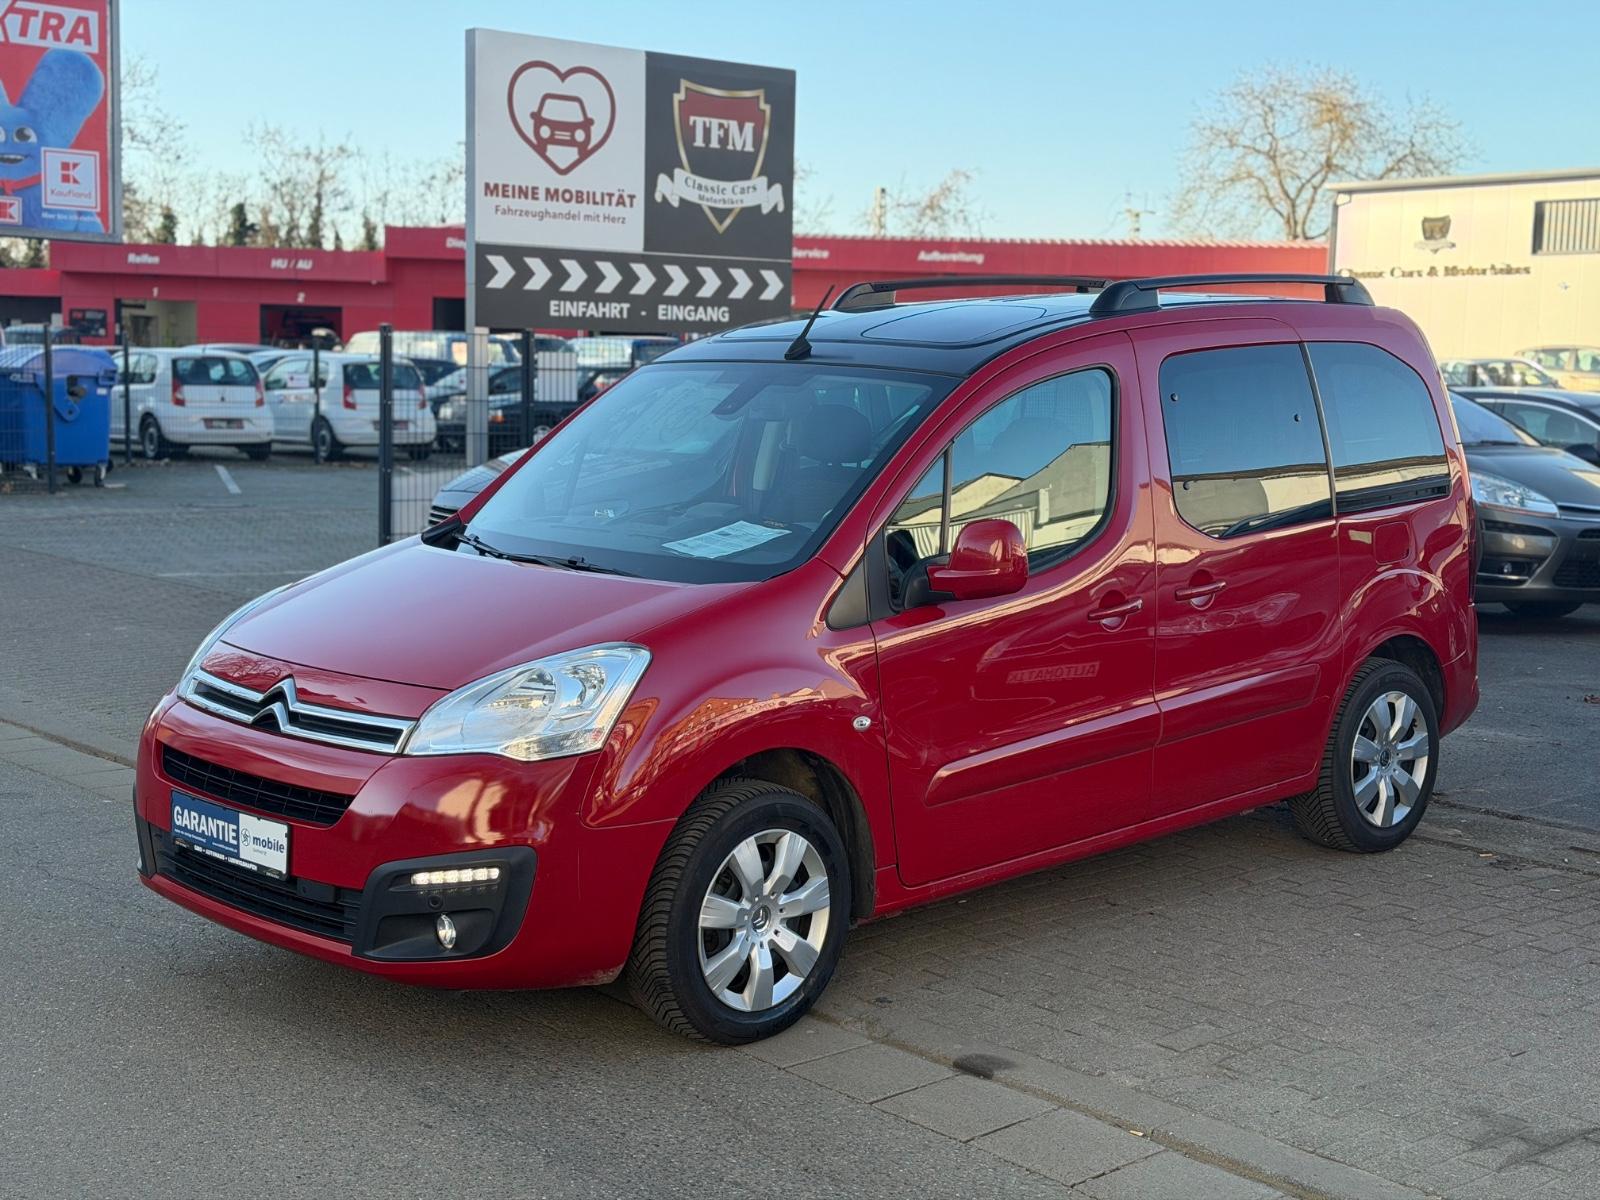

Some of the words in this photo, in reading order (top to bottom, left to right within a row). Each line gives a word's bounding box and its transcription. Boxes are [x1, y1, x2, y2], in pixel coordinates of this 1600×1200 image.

[689, 115, 755, 152] TFM
[483, 182, 540, 201] MEINE
[545, 187, 637, 209] MOBILITÄT
[684, 176, 727, 195] Classic
[731, 184, 757, 196] Cars
[698, 193, 744, 205] Motorbikes
[494, 204, 581, 222] Fahrzeughandel
[583, 211, 601, 222] mit
[602, 213, 627, 225] Herz
[127, 253, 160, 265] Reifen
[271, 257, 288, 269] HU
[296, 259, 313, 270] AU
[549, 300, 631, 319] EINFAHRT
[657, 304, 730, 323] EINGANG
[173, 805, 238, 846] GARANTIE
[252, 835, 285, 854] mobile
